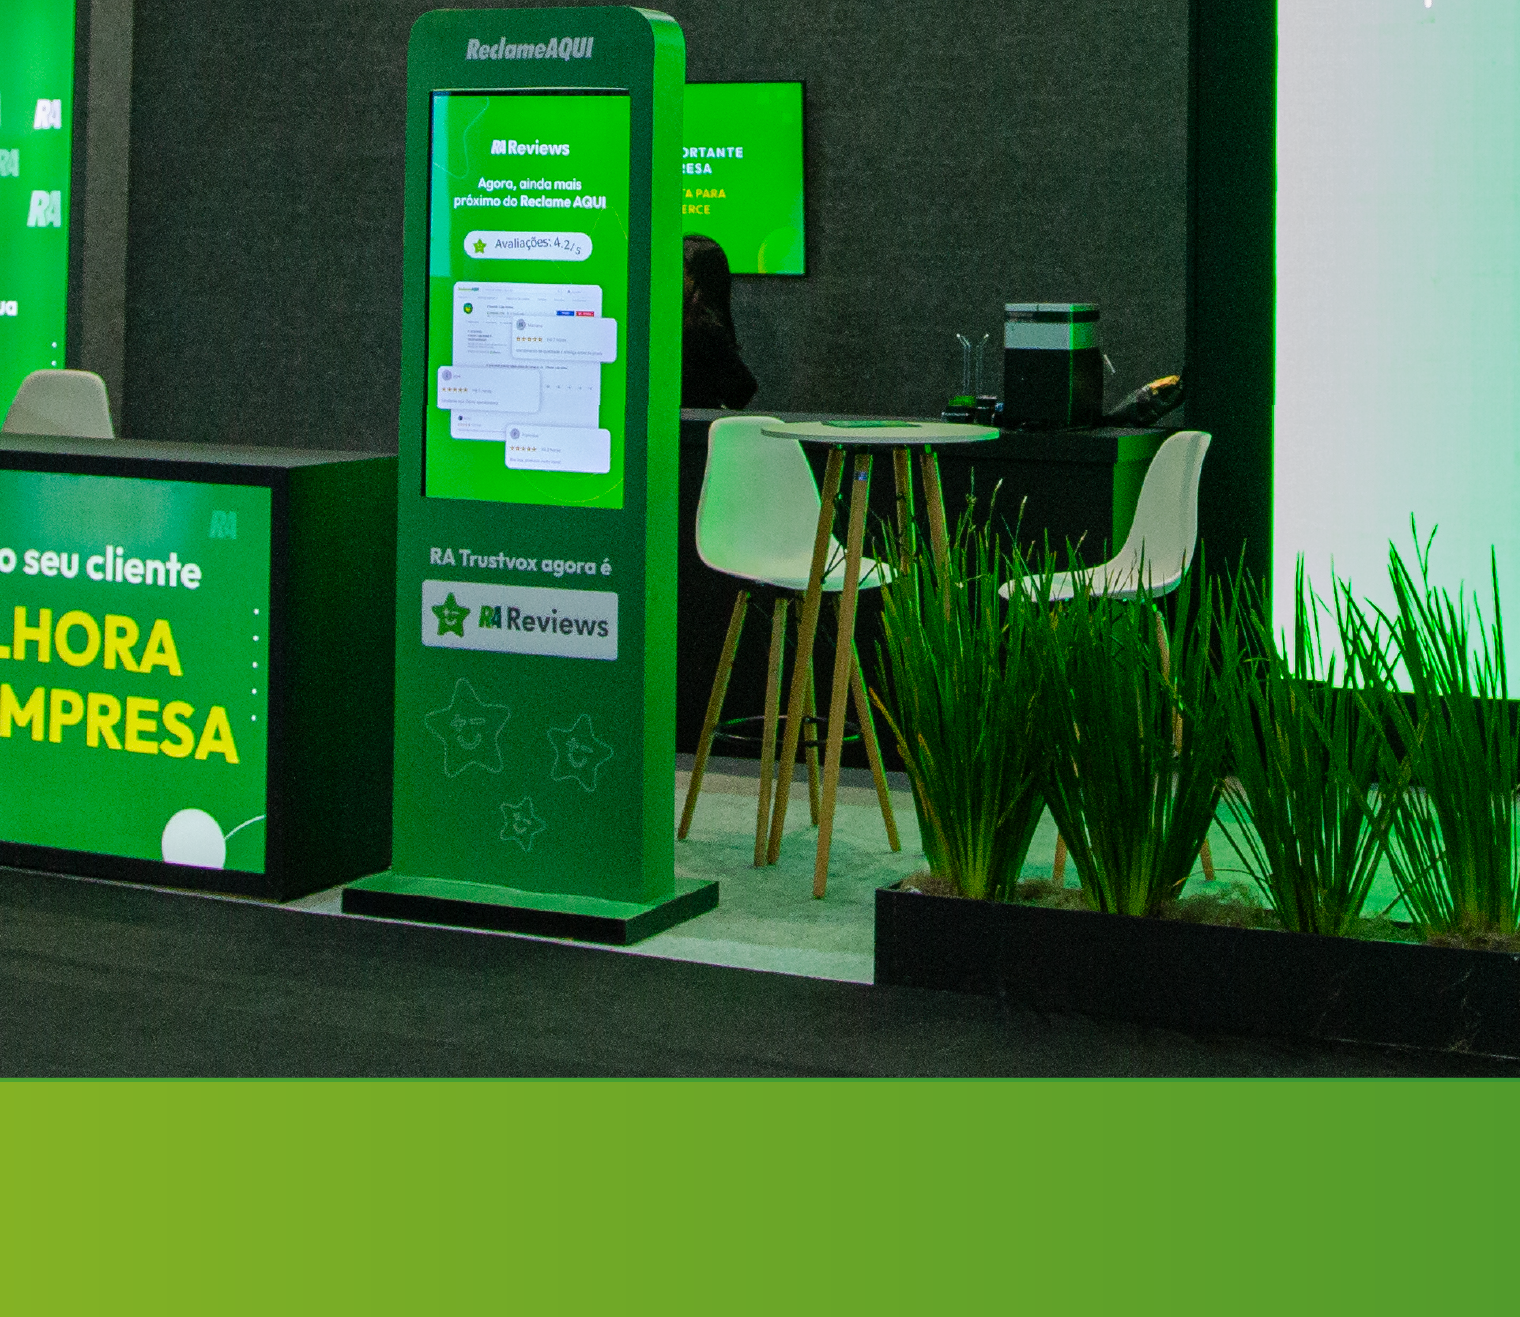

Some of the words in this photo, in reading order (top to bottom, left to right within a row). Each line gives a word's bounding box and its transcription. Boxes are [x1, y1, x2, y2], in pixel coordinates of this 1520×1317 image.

[465, 36, 594, 62] ReclameAQUI
[33, 98, 62, 130] RA
[508, 138, 570, 156] Reviews
[478, 176, 517, 192] Agora,
[519, 178, 552, 191] ainda
[554, 178, 582, 191] mais
[26, 189, 62, 228] RA
[453, 194, 501, 209] próximo
[503, 195, 518, 207] do
[520, 195, 571, 208] Reclame
[573, 195, 607, 209] AQUI
[23, 547, 80, 579] seu
[86, 544, 203, 591] cliente
[429, 547, 455, 567] RA
[459, 548, 538, 573] Trustvox
[541, 558, 596, 578] agora
[600, 557, 613, 576] é
[477, 604, 502, 629] RA
[506, 602, 610, 638] Reviews
